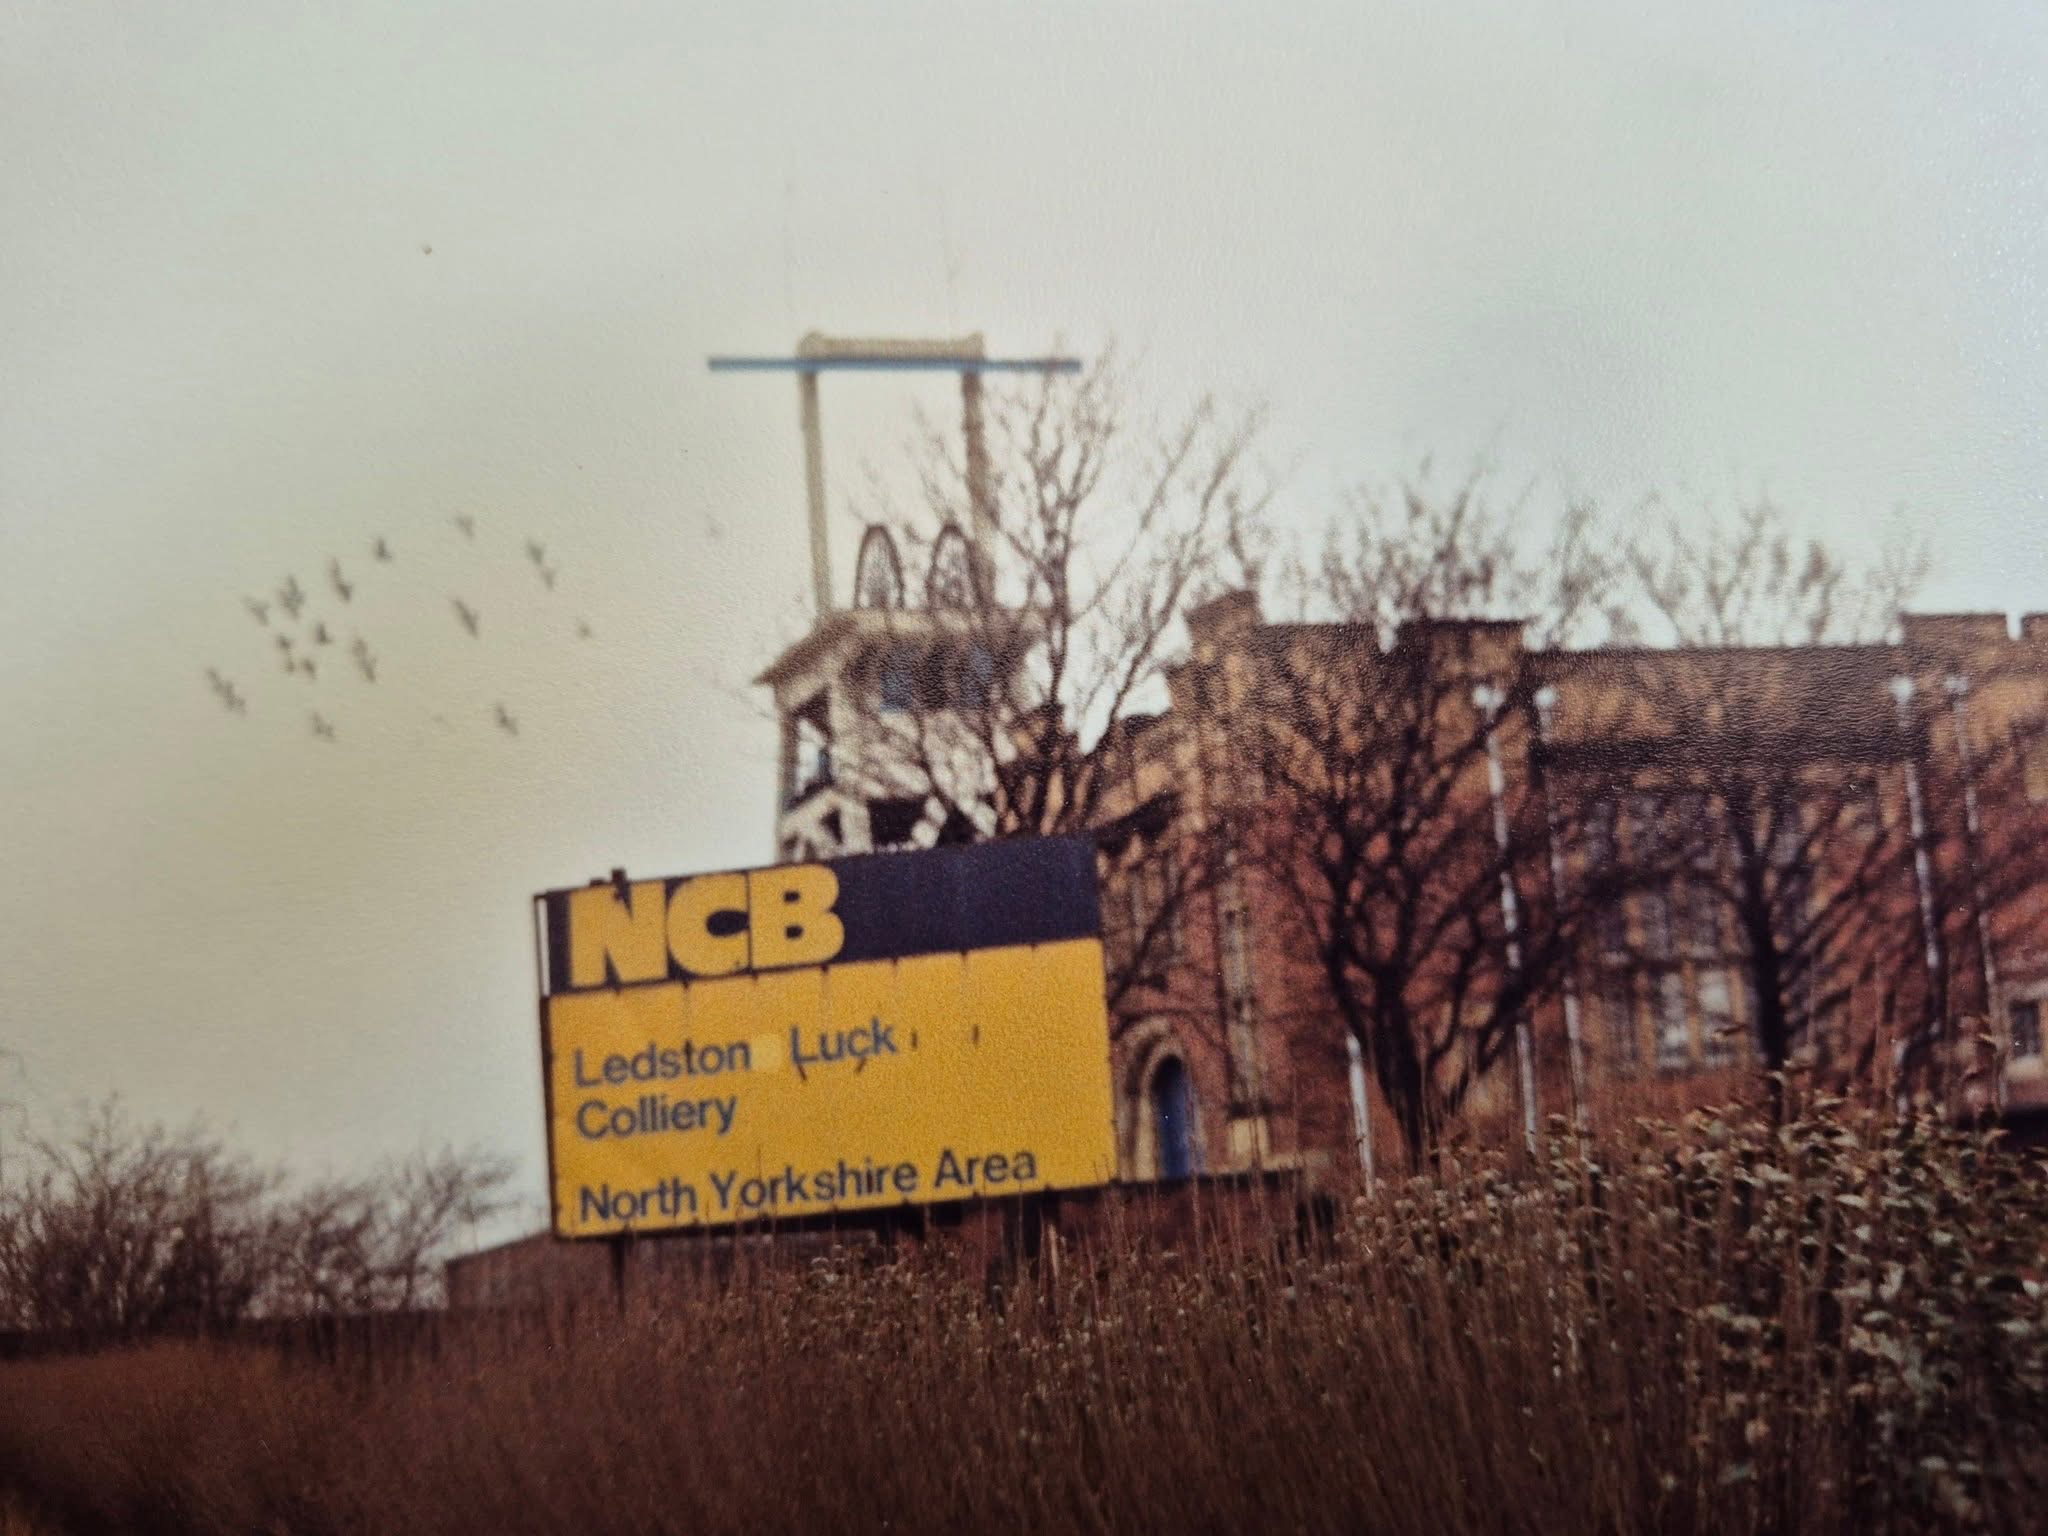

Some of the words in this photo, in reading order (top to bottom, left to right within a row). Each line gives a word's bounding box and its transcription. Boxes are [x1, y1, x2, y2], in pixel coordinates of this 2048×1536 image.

[569, 863, 845, 988] NCB
[574, 1039, 750, 1088] Ledston
[790, 1017, 896, 1065] Luck
[576, 1094, 737, 1141] Colliery
[579, 1176, 697, 1223] North
[710, 1158, 919, 1209] Yorkshire
[934, 1148, 1037, 1187] Area
